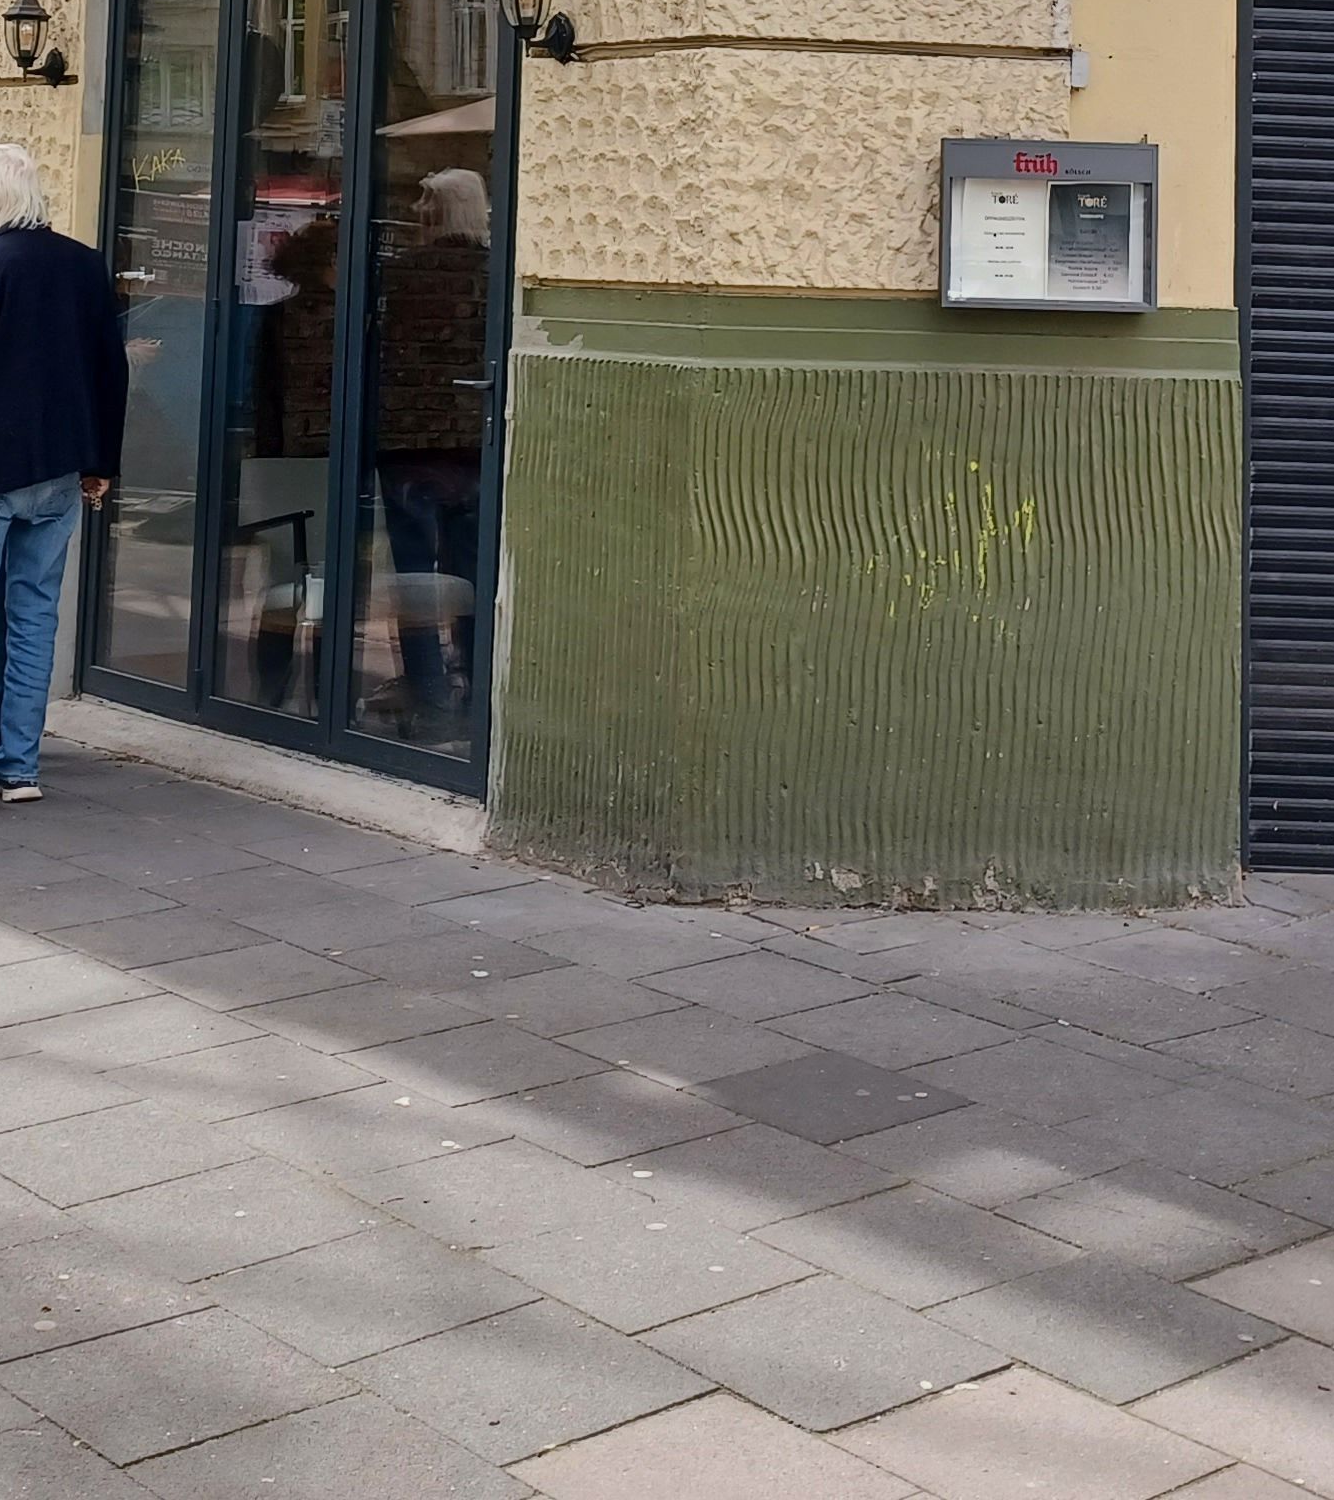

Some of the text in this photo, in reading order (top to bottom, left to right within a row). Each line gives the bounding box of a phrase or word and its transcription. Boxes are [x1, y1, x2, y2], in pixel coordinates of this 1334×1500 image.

[132, 149, 186, 192] KAKA
[1013, 152, 1058, 176] früh
[993, 192, 1019, 204] TORÉ
[1078, 195, 1107, 208] TORÉ
